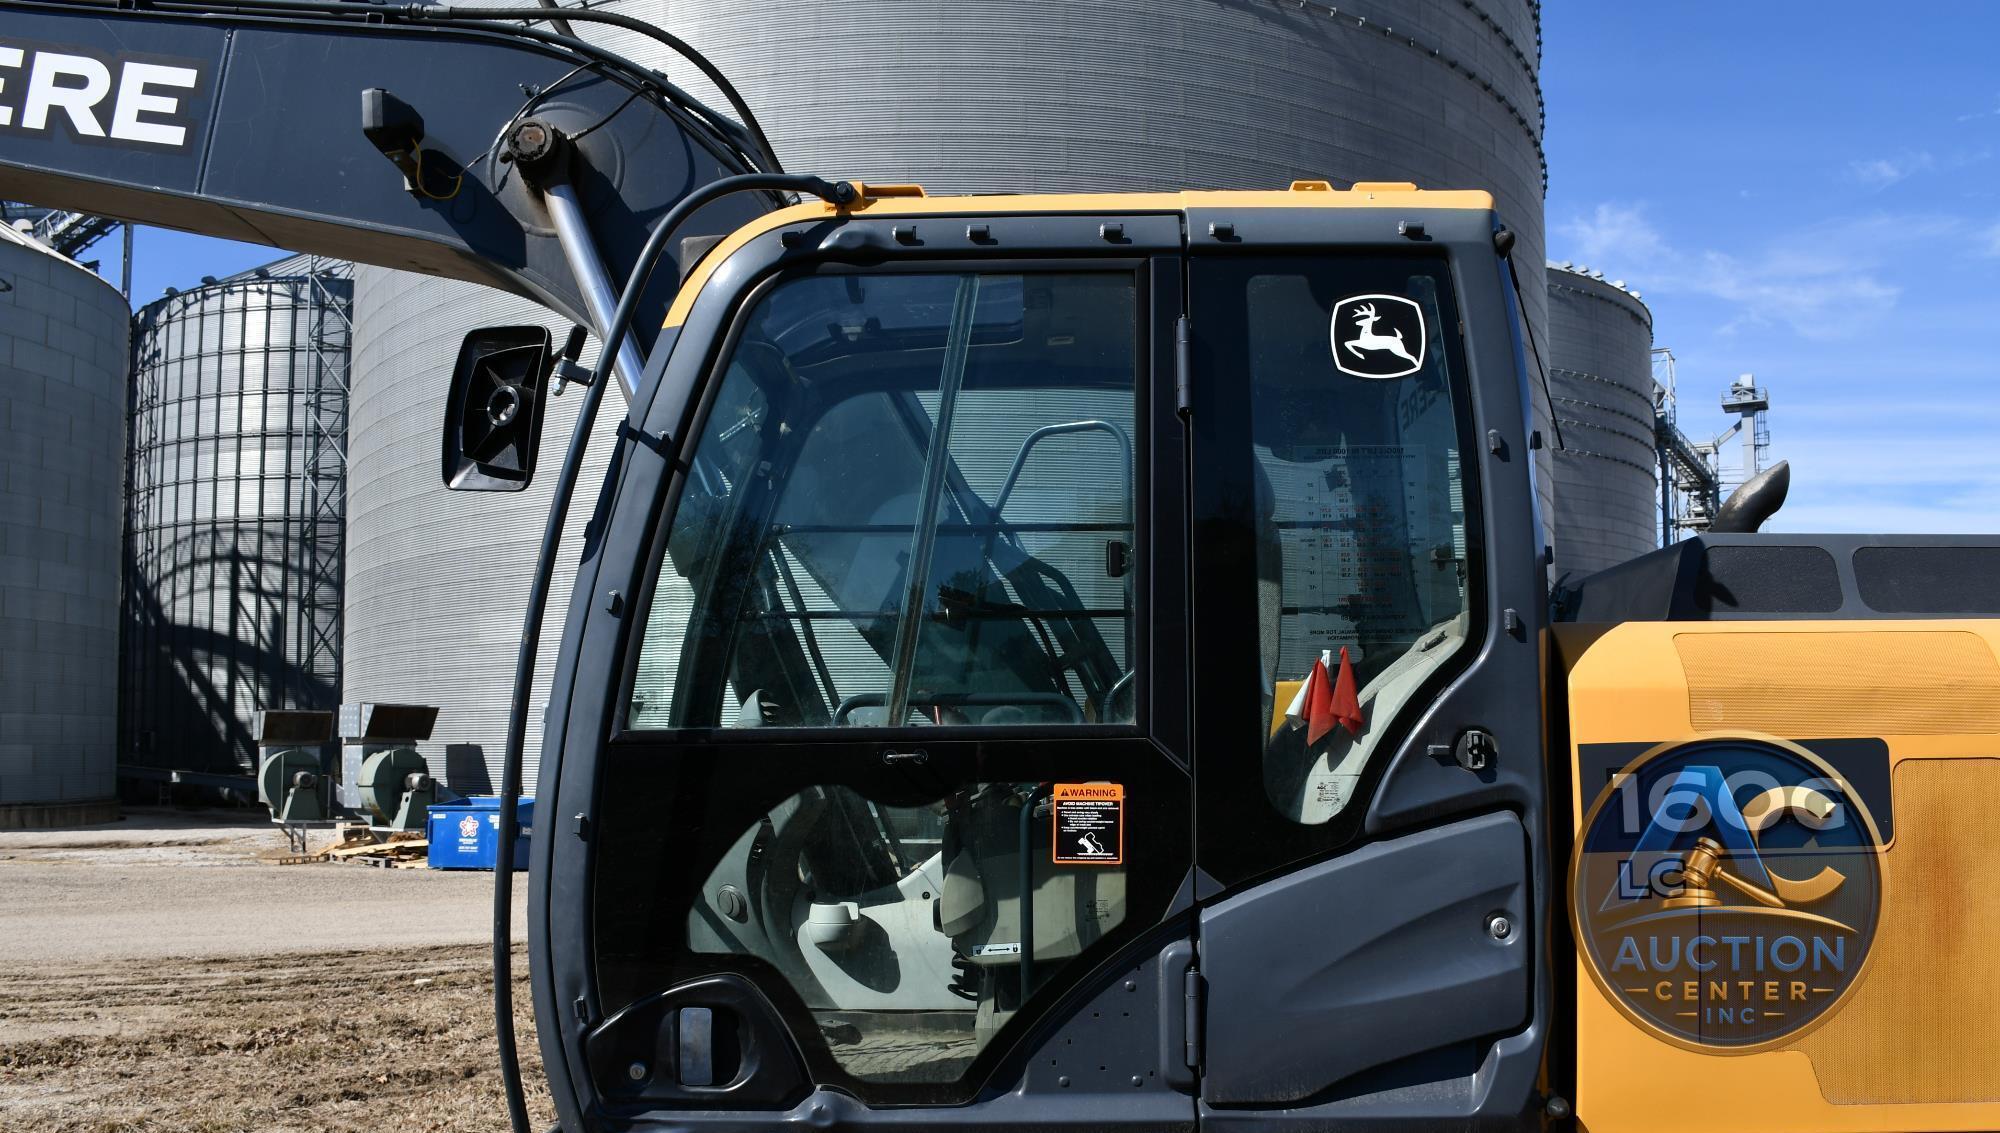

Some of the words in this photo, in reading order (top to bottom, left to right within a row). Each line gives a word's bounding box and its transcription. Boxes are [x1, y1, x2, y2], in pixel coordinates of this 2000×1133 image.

[0, 46, 198, 146] RE
[1070, 789, 1116, 797] WARNING
[1612, 769, 1845, 834] 160G
[1618, 859, 1687, 898] LC
